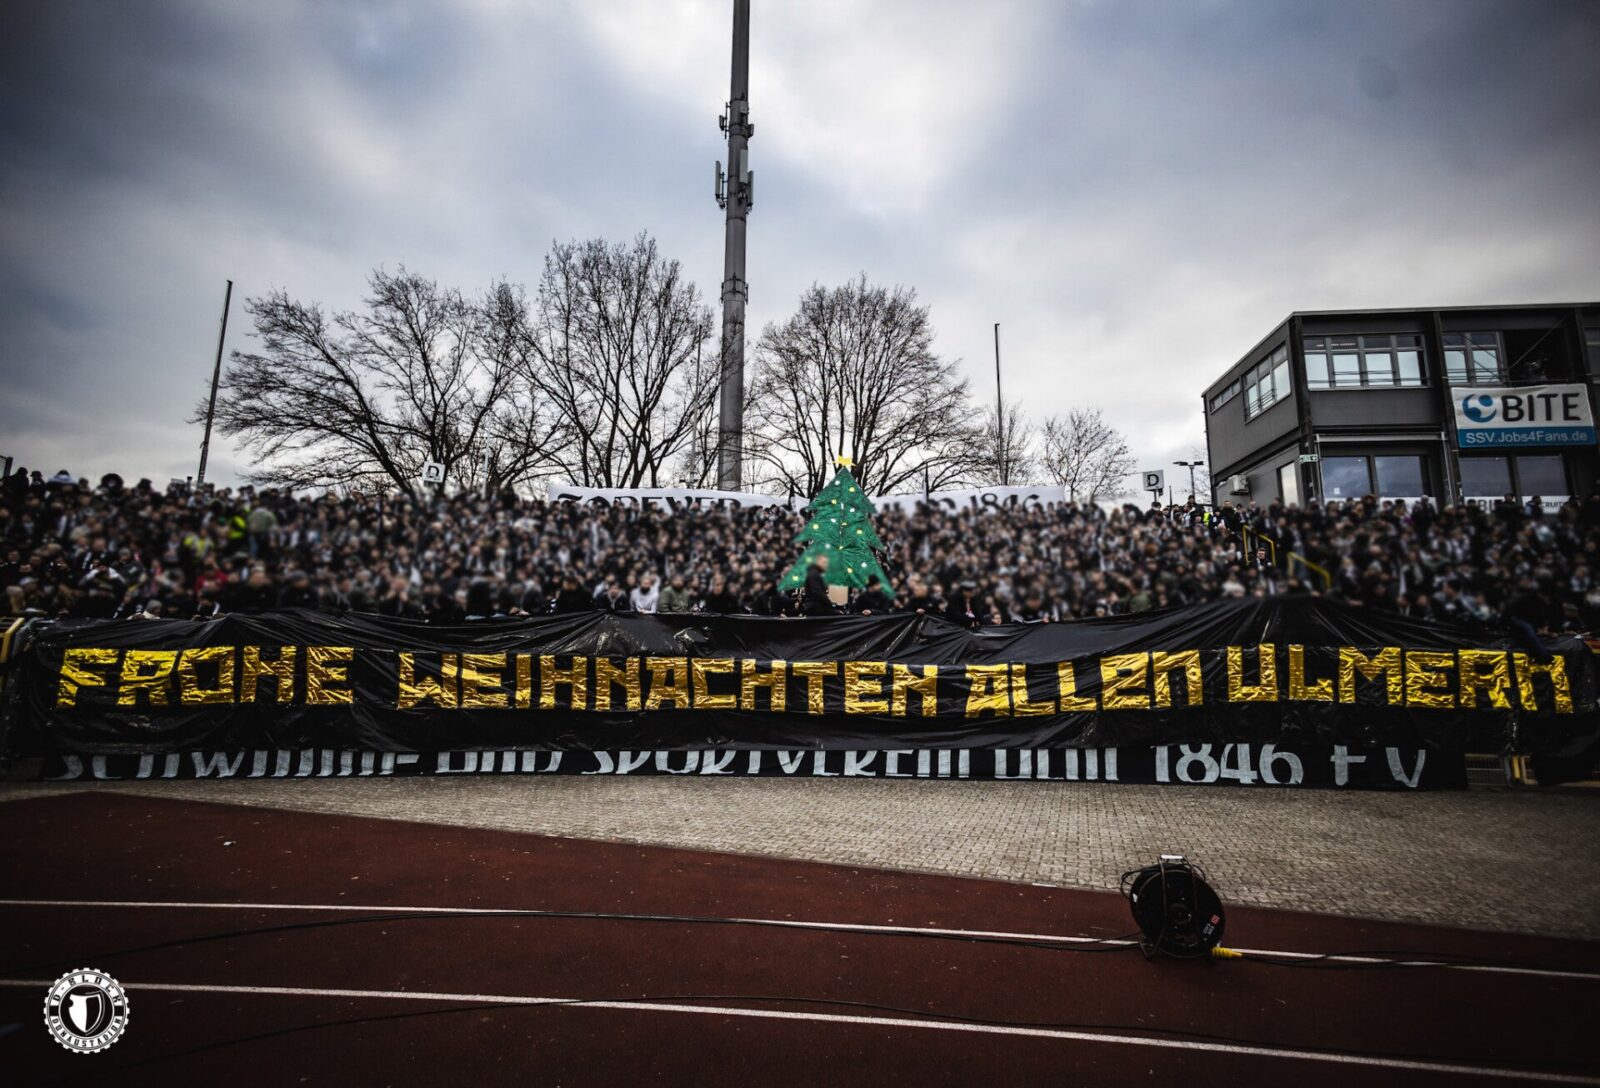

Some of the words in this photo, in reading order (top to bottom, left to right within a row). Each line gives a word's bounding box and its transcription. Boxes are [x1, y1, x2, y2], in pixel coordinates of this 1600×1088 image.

[1501, 393, 1582, 422] BITE
[1465, 430, 1588, 444] SSV.Jobs4Fans.de
[1146, 473, 1160, 487] D
[56, 645, 354, 706] FROHE
[396, 651, 939, 718] WEIHNACHTEN
[1226, 643, 1574, 714] ULMERN
[1155, 743, 1304, 784] 1846
